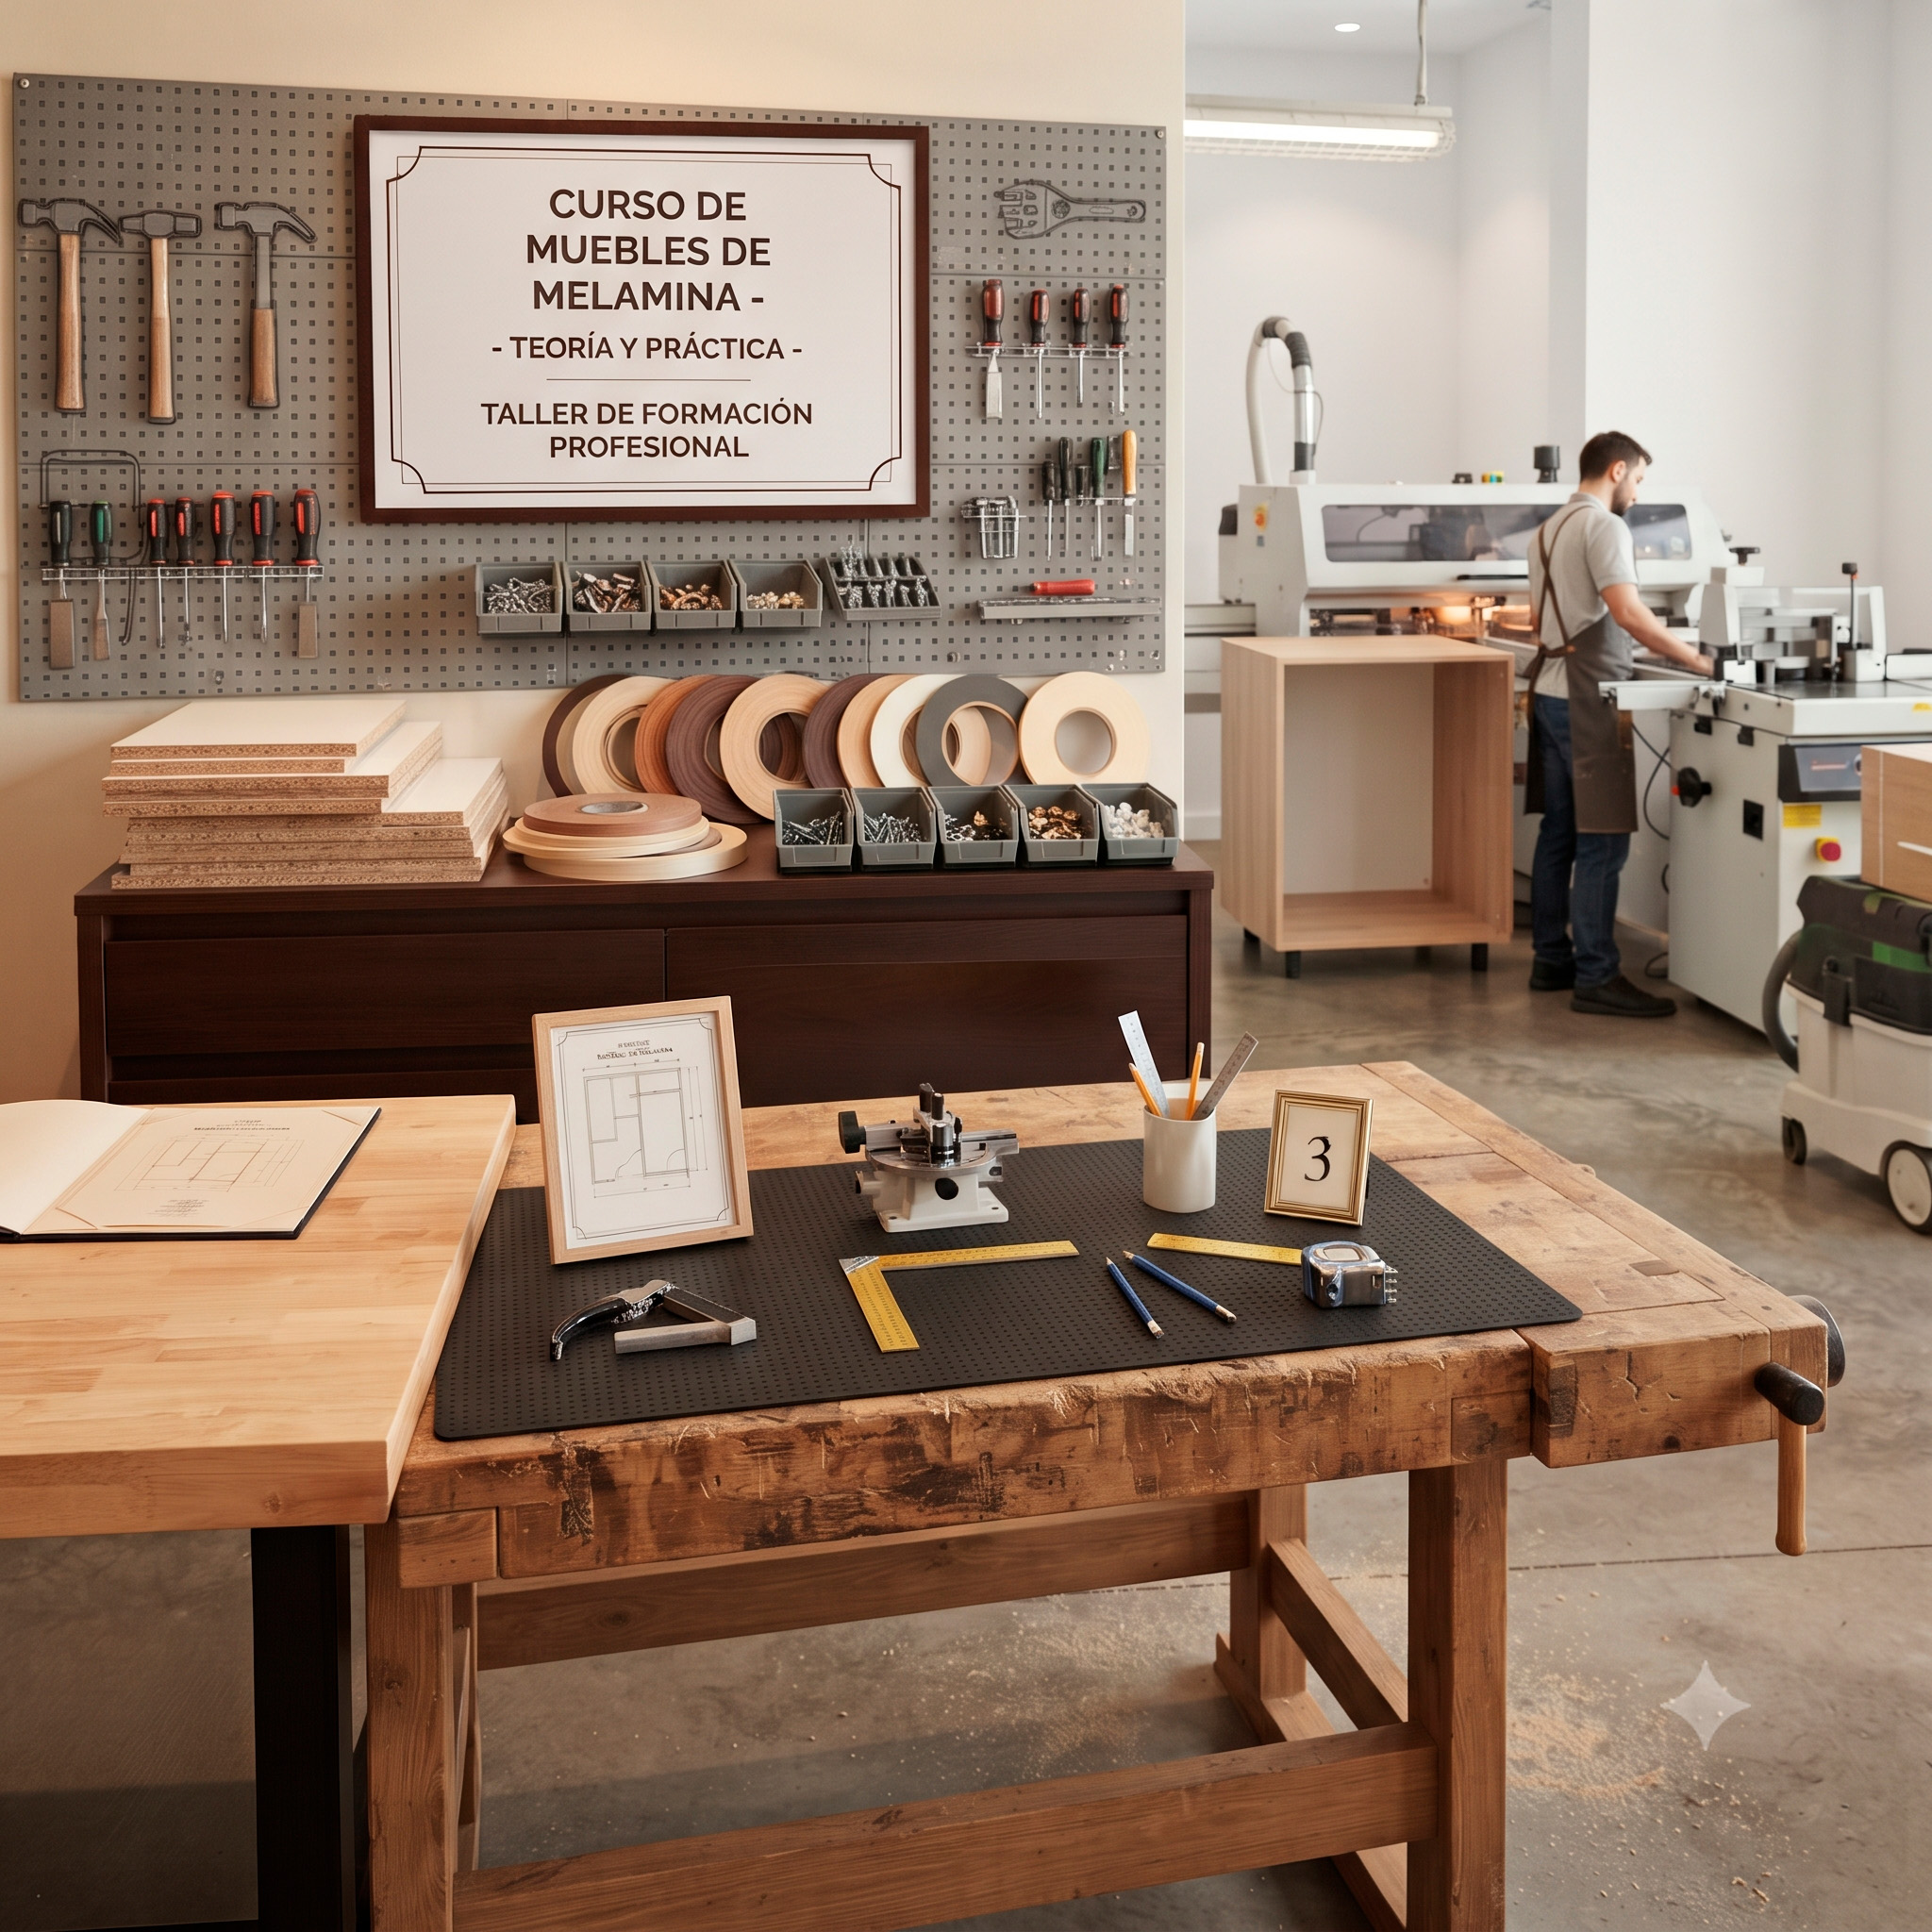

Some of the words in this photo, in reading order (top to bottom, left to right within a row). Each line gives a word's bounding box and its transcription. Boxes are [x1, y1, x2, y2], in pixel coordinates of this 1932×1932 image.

[549, 189, 686, 221] CURSO
[697, 191, 747, 222] DE
[526, 234, 710, 266] MUEBLES
[722, 237, 771, 266] DE
[533, 280, 741, 311] MELAMINA
[508, 330, 614, 359] TEORÍA
[619, 337, 639, 359] Y
[646, 331, 785, 359] PRÁCTICA
[480, 402, 589, 425] TALLER
[597, 402, 635, 425] DE
[642, 397, 812, 425] FORMACIÓN
[550, 435, 750, 458] PROFESIONAL
[1304, 1136, 1332, 1182] 3
